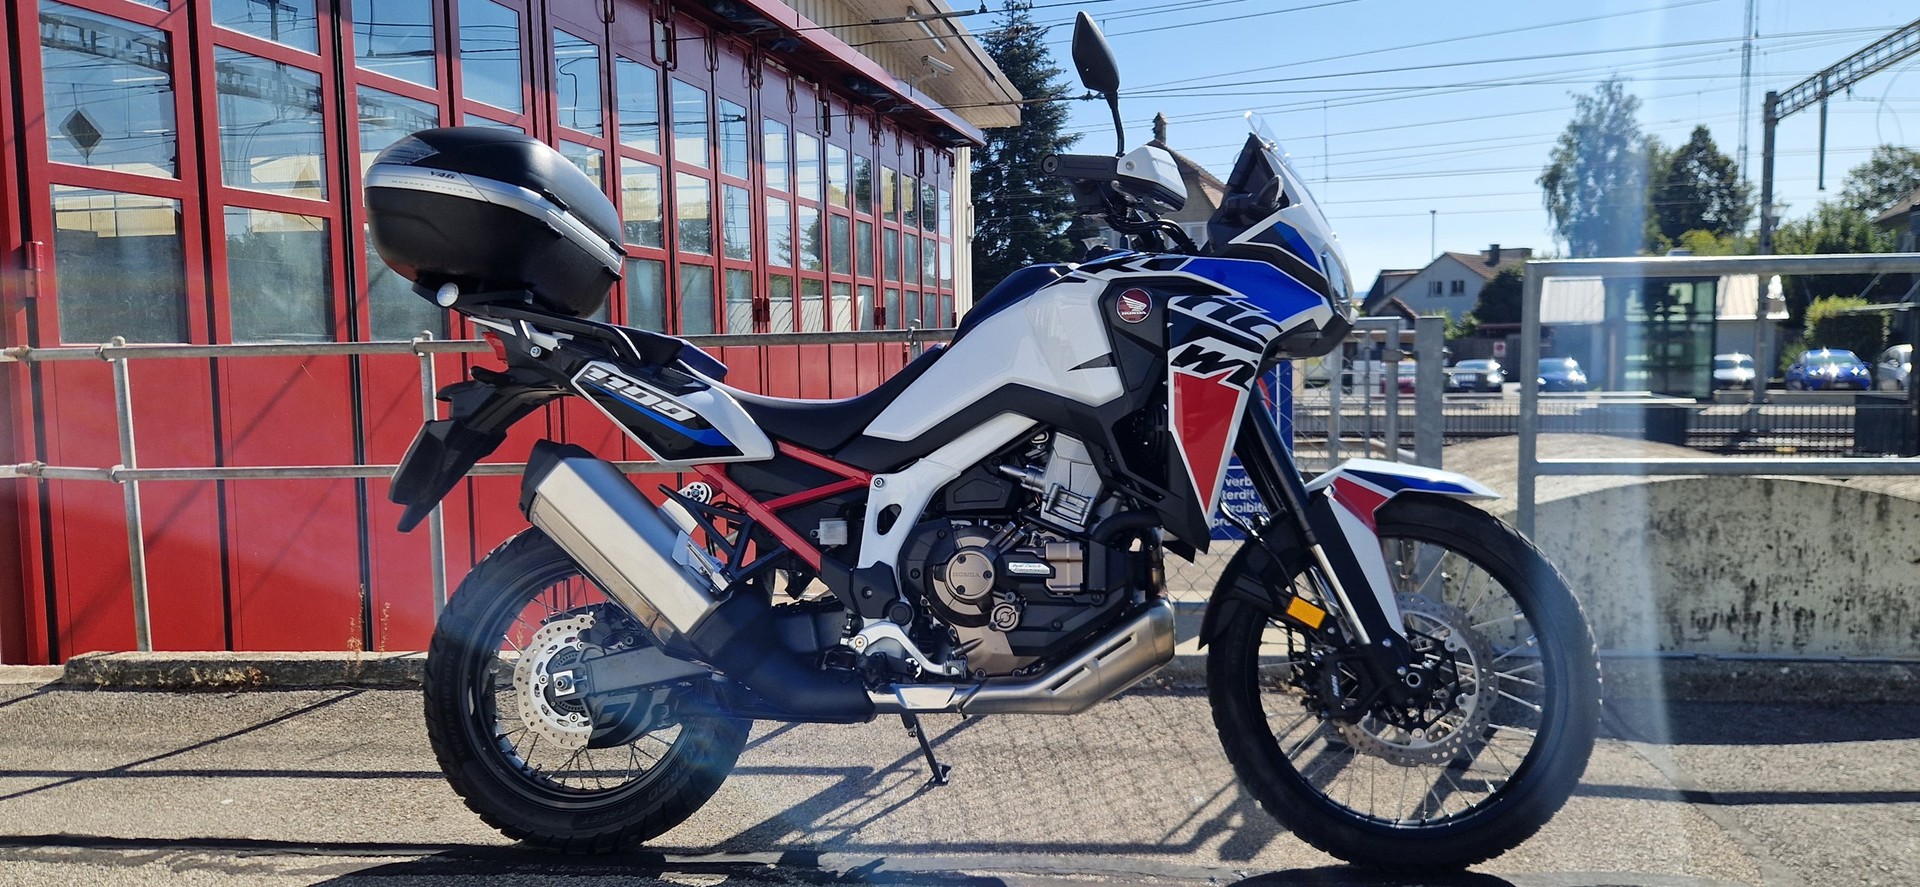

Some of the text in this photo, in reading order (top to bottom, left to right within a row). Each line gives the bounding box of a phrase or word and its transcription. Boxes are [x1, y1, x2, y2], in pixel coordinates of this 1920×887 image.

[431, 171, 456, 179] V46
[583, 367, 697, 421] 1100
[1225, 476, 1253, 487] verb
